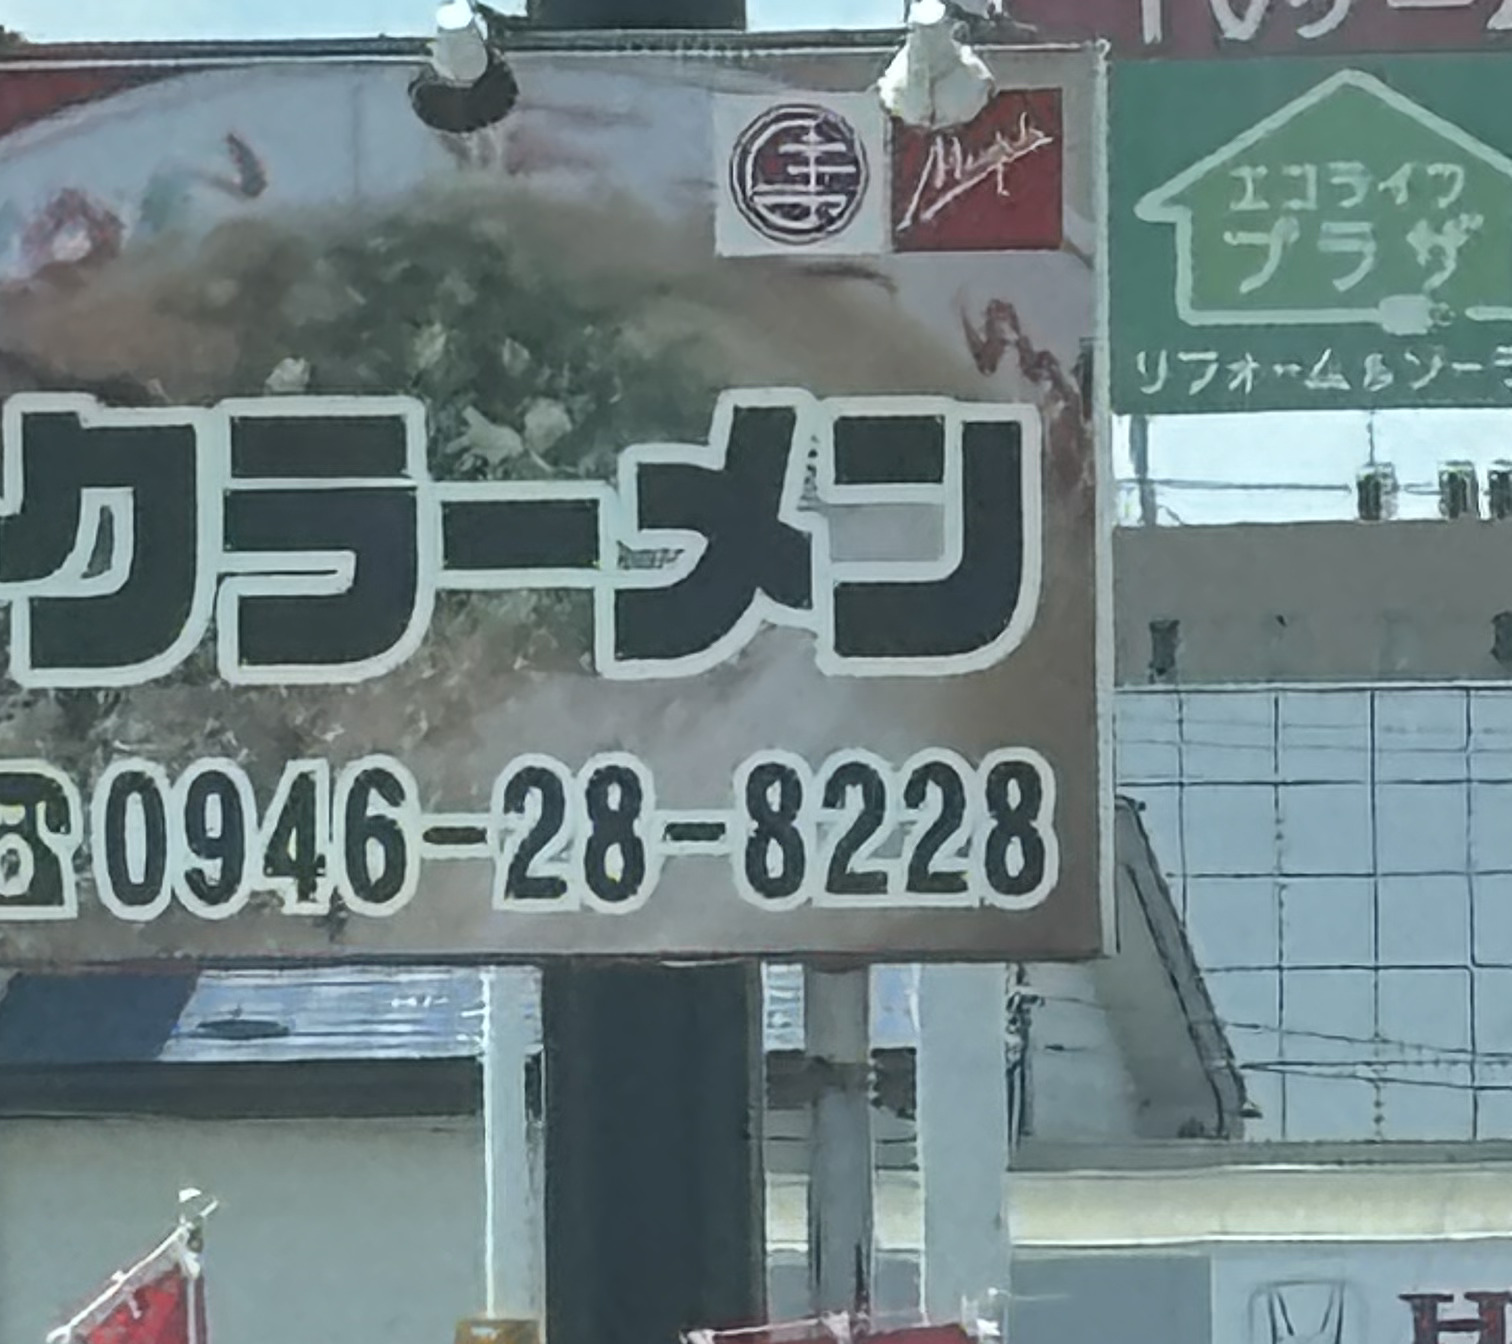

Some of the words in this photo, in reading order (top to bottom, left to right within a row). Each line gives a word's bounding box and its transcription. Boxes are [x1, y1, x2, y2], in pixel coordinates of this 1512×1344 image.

[1228, 161, 1464, 211] エコライフ
[1223, 212, 1484, 294] プラザ
[94, 748, 1058, 922] 0946-28-8228
